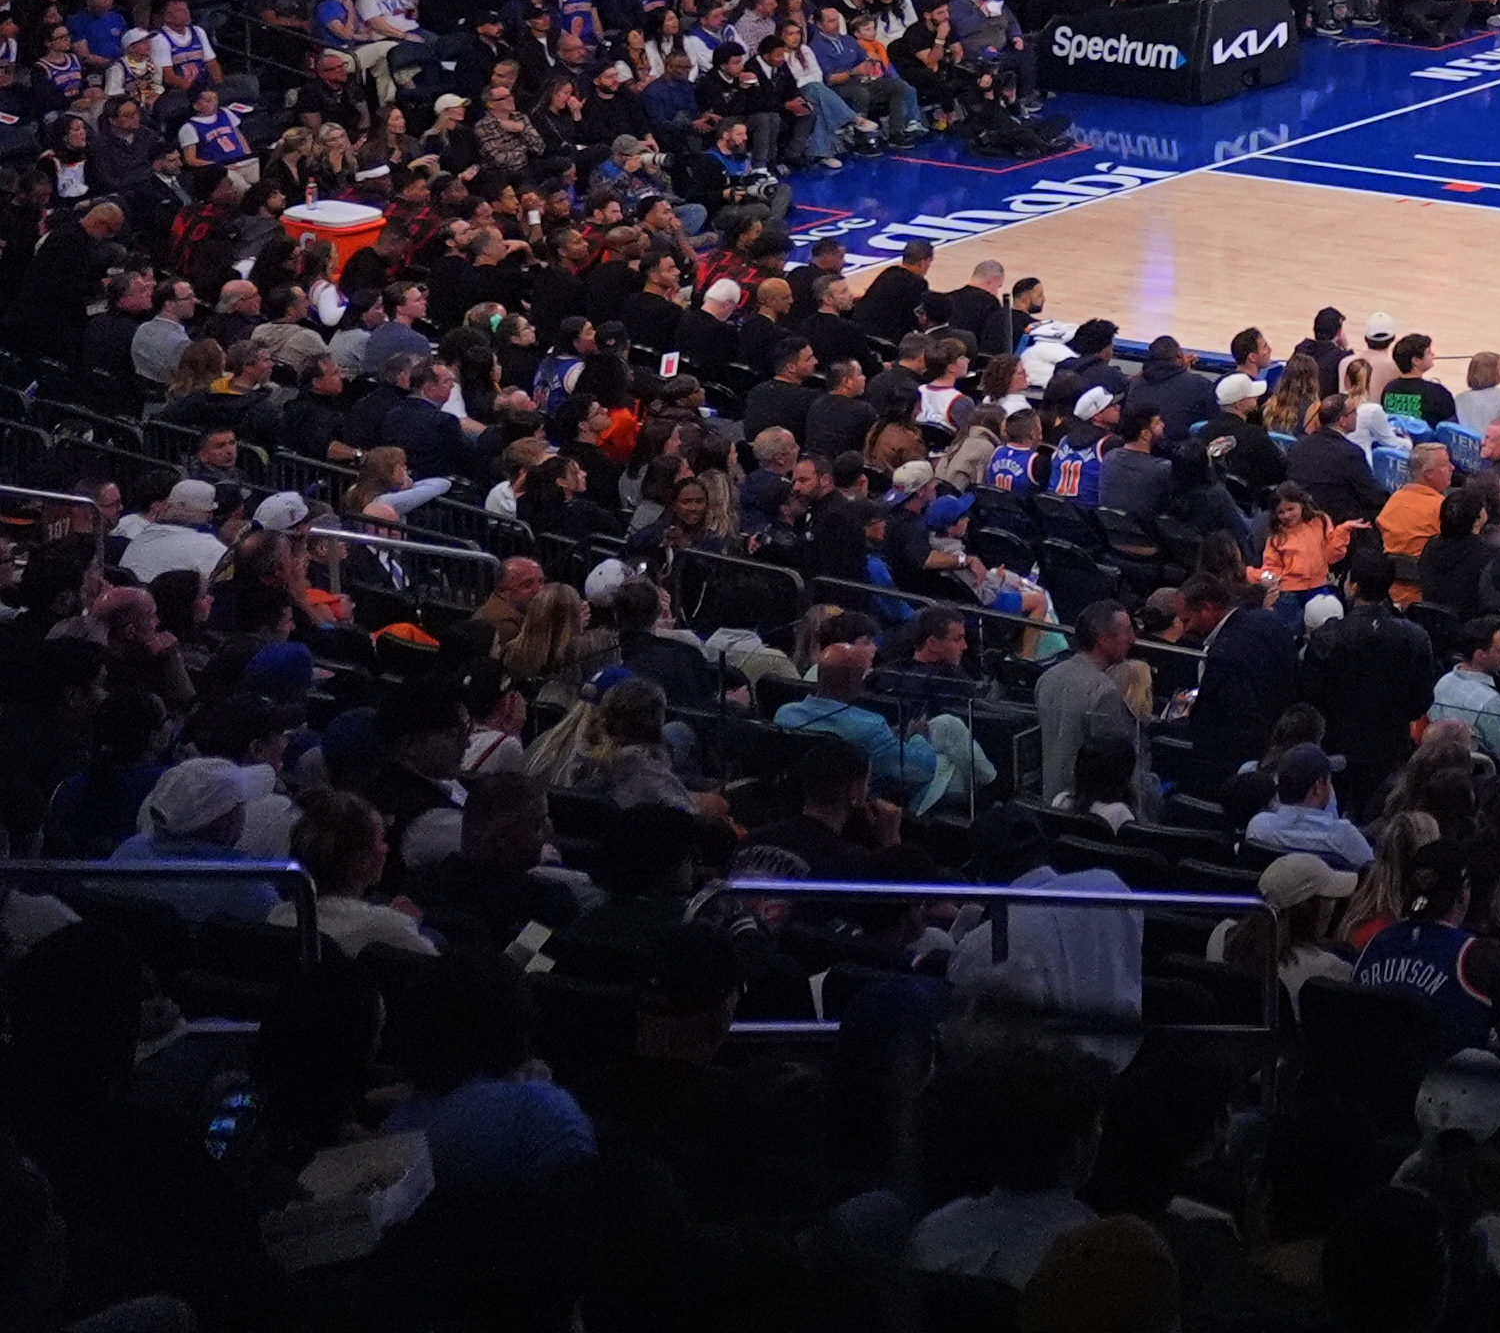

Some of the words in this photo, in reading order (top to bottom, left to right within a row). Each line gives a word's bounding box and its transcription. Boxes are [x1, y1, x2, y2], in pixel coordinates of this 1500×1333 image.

[1051, 25, 1179, 70] Spectrum
[1056, 459, 1083, 497] 11
[1360, 958, 1449, 997] BRUNSON
